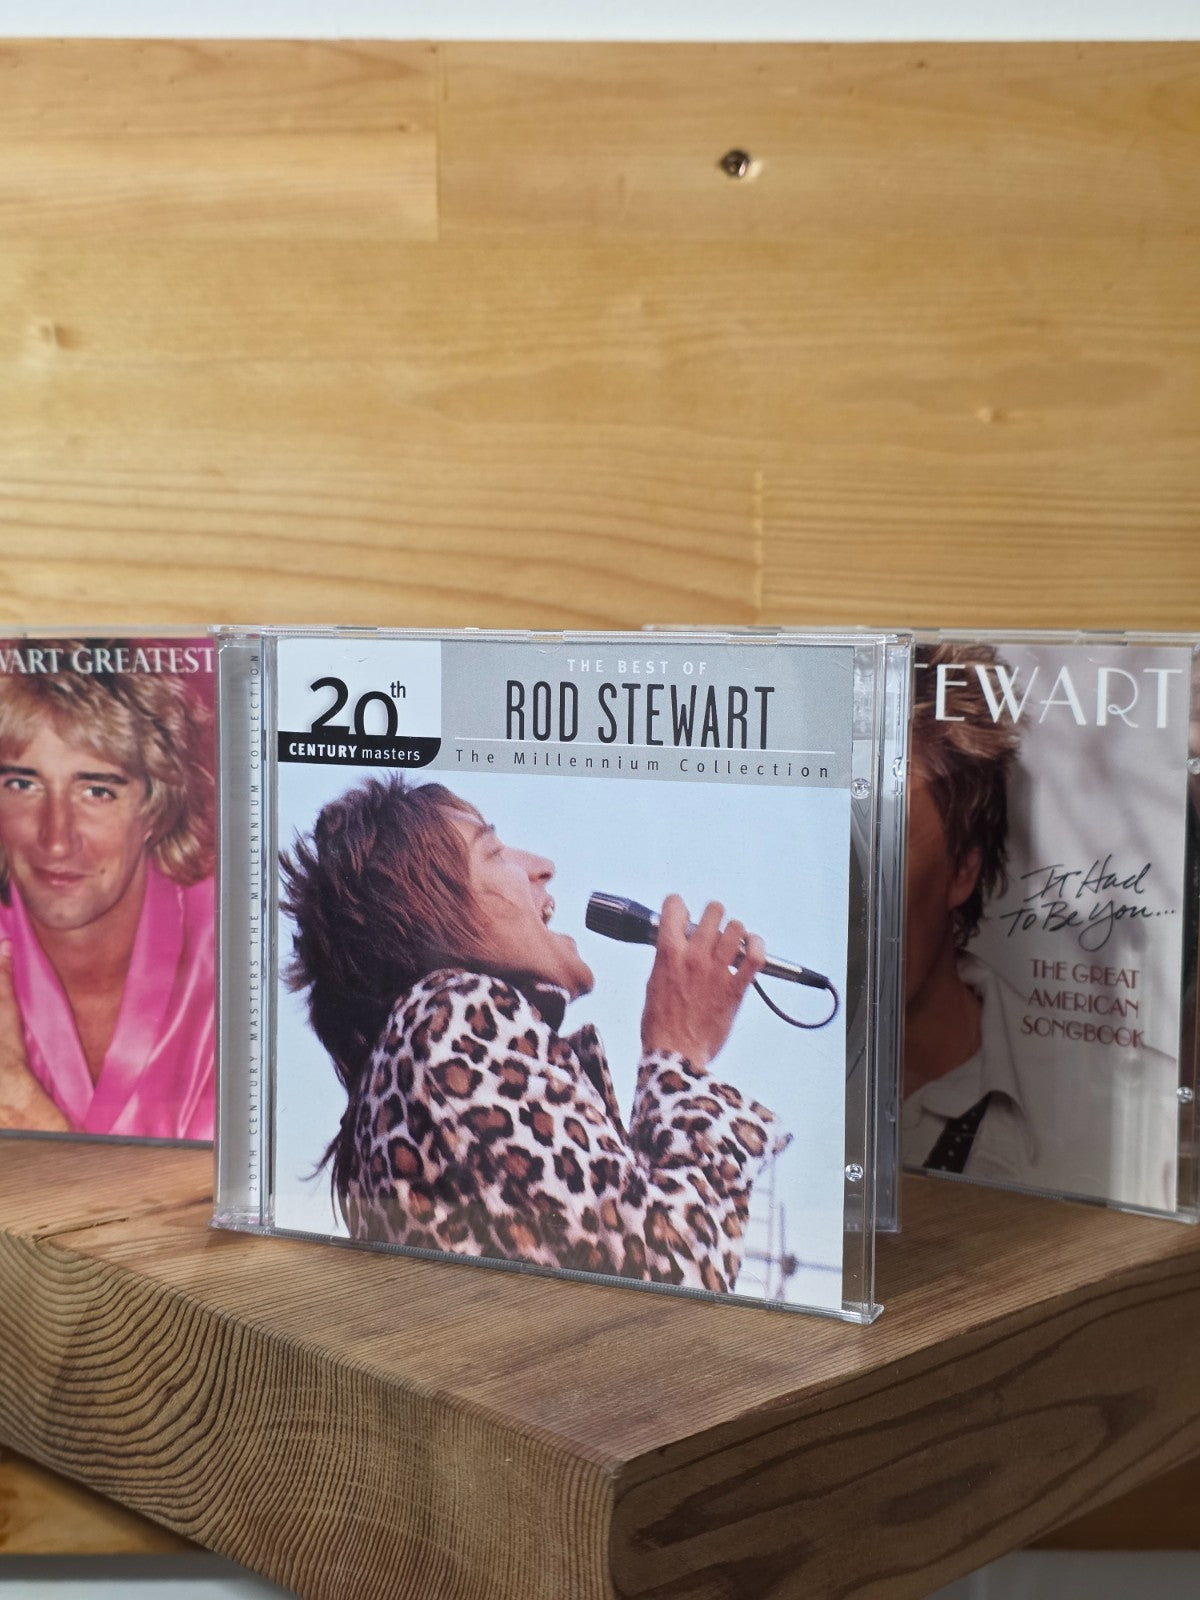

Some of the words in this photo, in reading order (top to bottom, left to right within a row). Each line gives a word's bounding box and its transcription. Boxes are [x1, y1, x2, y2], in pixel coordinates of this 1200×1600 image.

[71, 647, 214, 674] GREATEST
[567, 658, 604, 673] THE
[618, 660, 668, 675] BEST
[683, 662, 708, 675] OF
[250, 655, 259, 769] COLLECTION
[914, 664, 1183, 728] EWART
[506, 680, 579, 742] ROD
[598, 682, 775, 750] STEWART
[289, 742, 357, 758] CENTURY
[361, 747, 420, 761] masters
[456, 749, 495, 764] The
[514, 751, 659, 772] Millennium
[680, 757, 829, 778] Collection
[250, 785, 259, 900] MILLENNIUM
[1075, 854, 1151, 899] Had
[250, 915, 259, 945] THE
[1000, 907, 1038, 937] To
[1041, 900, 1084, 932] Be
[1030, 959, 1067, 982] THE
[1072, 963, 1139, 990] GREAT
[250, 960, 259, 1041] MASTERS
[1028, 987, 1139, 1019] AMERICAN
[1021, 1015, 1144, 1049] SONGBOOK
[249, 1055, 259, 1135] CENTURY
[248, 1149, 257, 1191] 20TH
